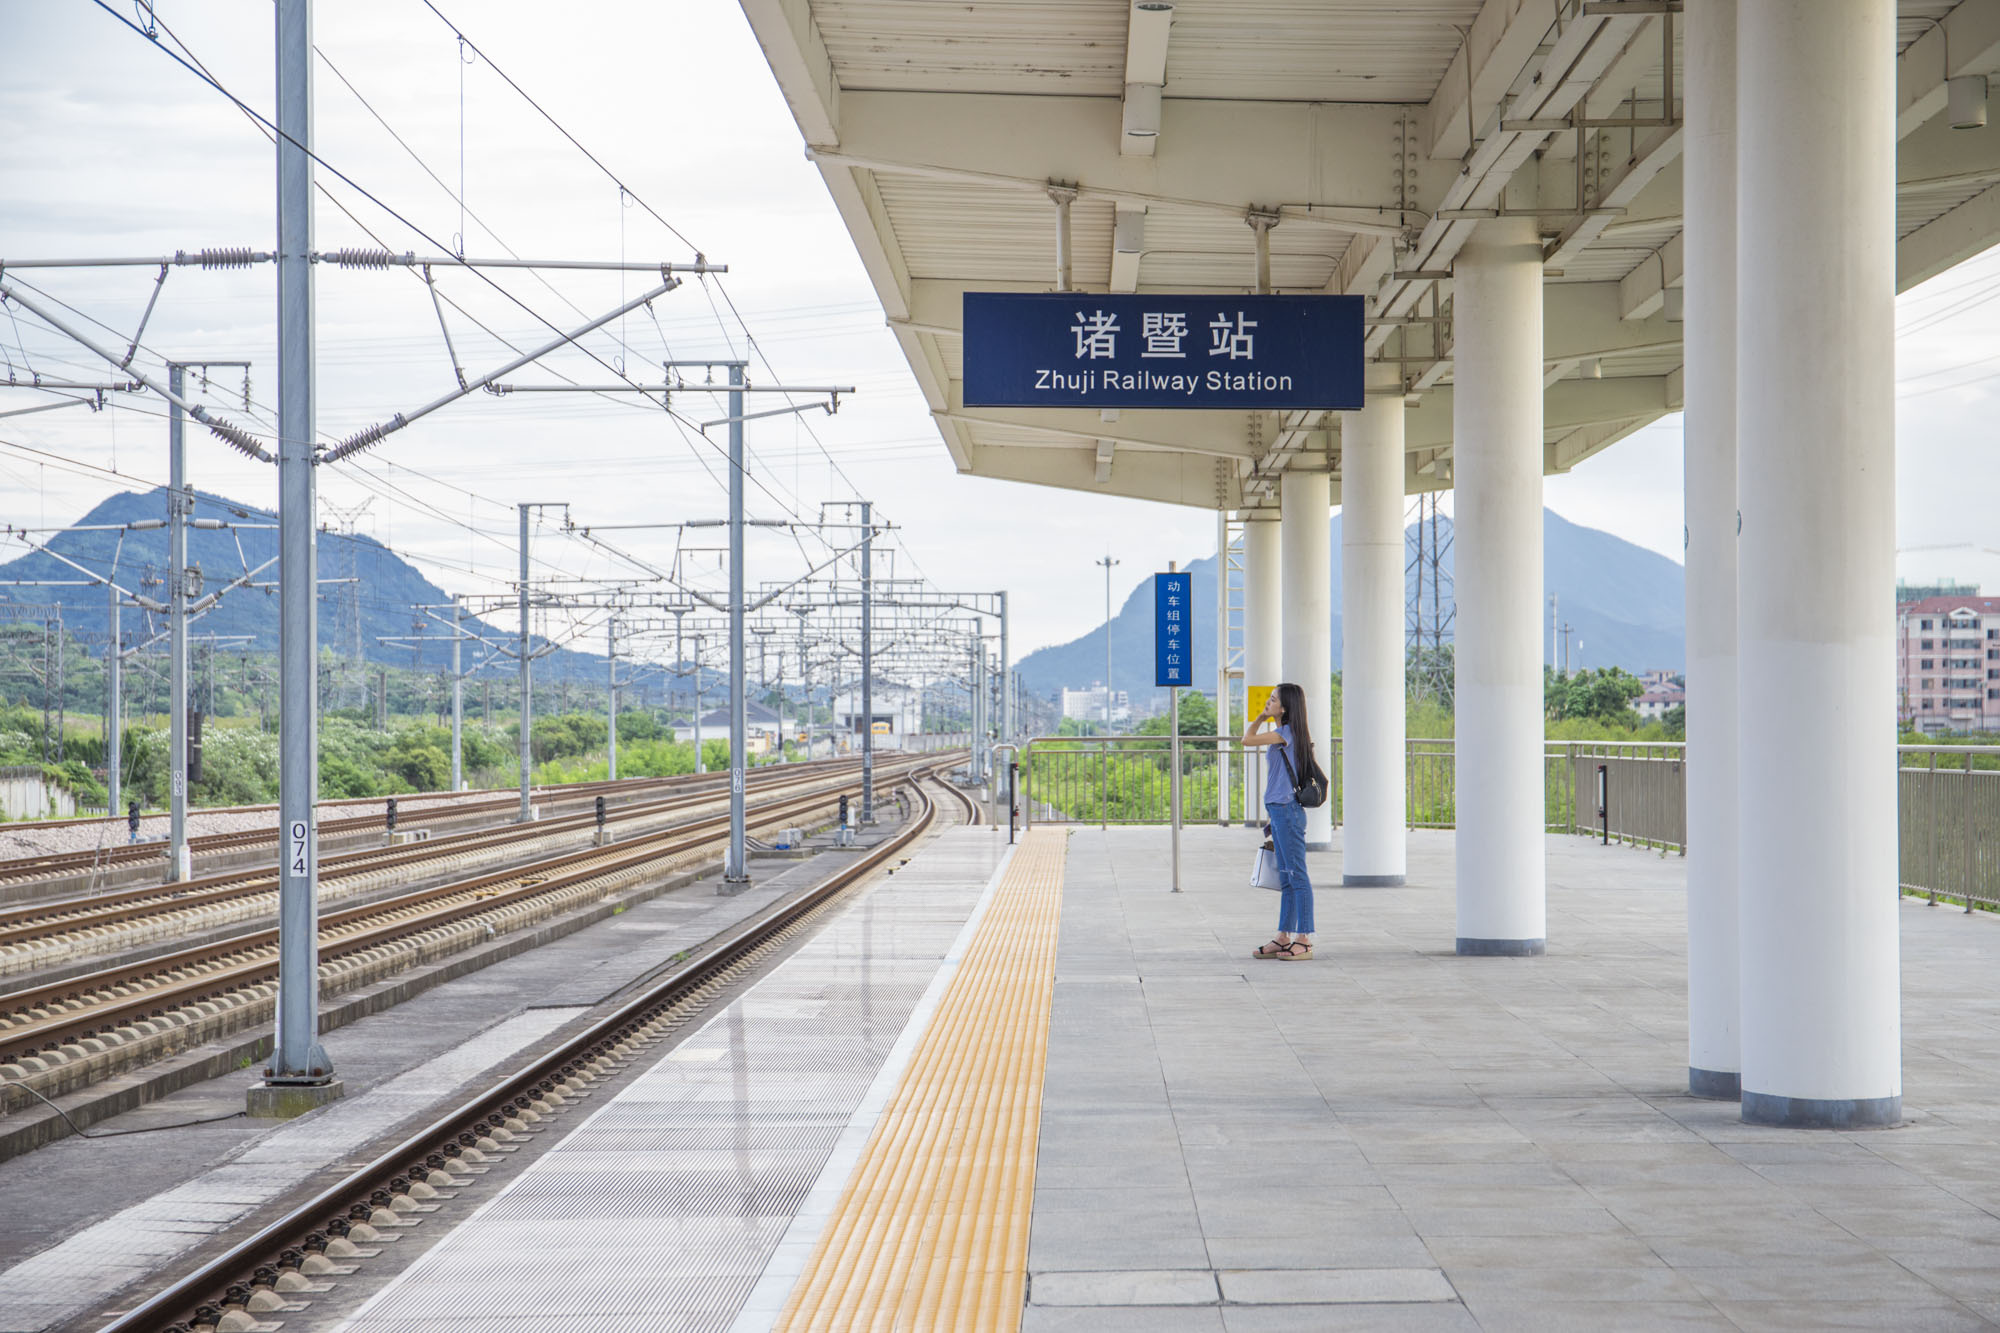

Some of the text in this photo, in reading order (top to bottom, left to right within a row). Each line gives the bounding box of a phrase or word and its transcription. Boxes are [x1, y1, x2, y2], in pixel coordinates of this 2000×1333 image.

[1071, 310, 1258, 360] 诸暨站
[1035, 370, 1292, 395] Zhuji Railway Station
[1167, 581, 1180, 679] 动车组停车位置
[292, 823, 306, 874] 074
